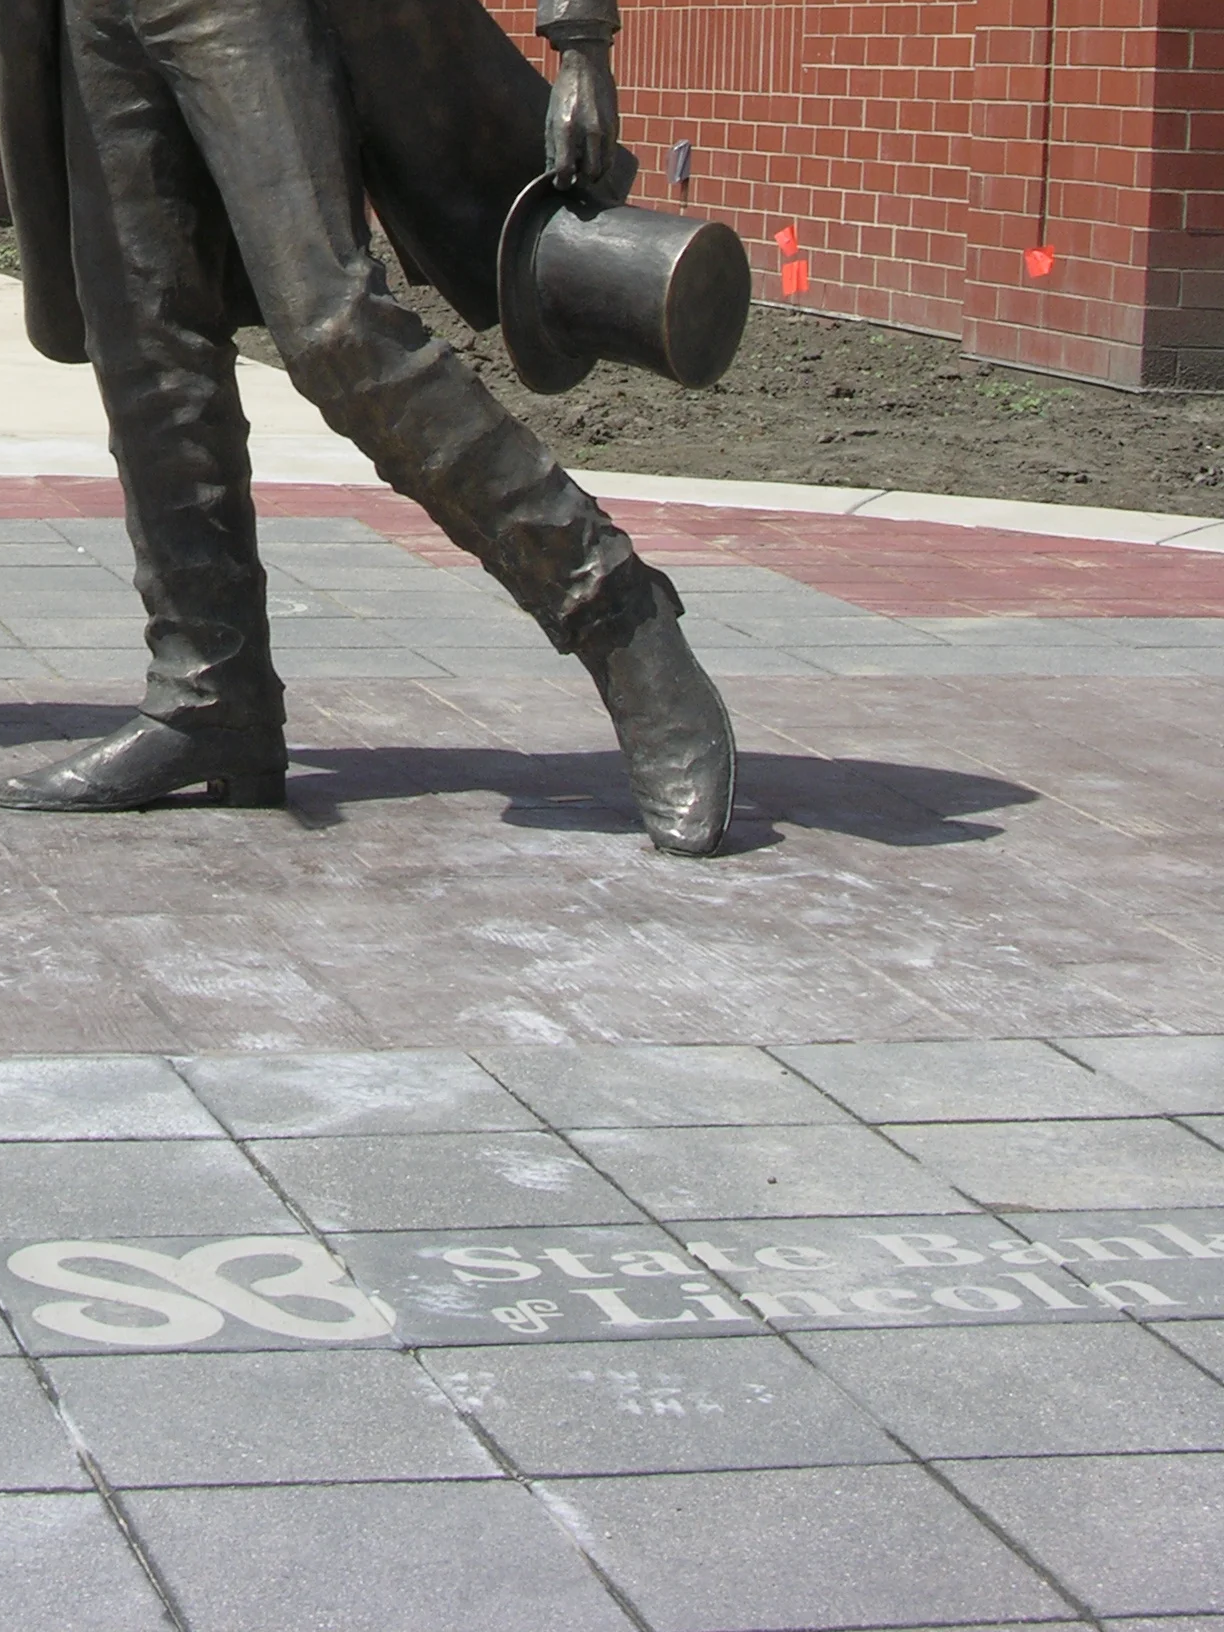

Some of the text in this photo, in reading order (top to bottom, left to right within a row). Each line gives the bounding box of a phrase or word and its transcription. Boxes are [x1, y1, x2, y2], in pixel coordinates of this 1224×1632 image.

[443, 1224, 1224, 1282] State Bank
[491, 1272, 1188, 1334] of Lincoln
